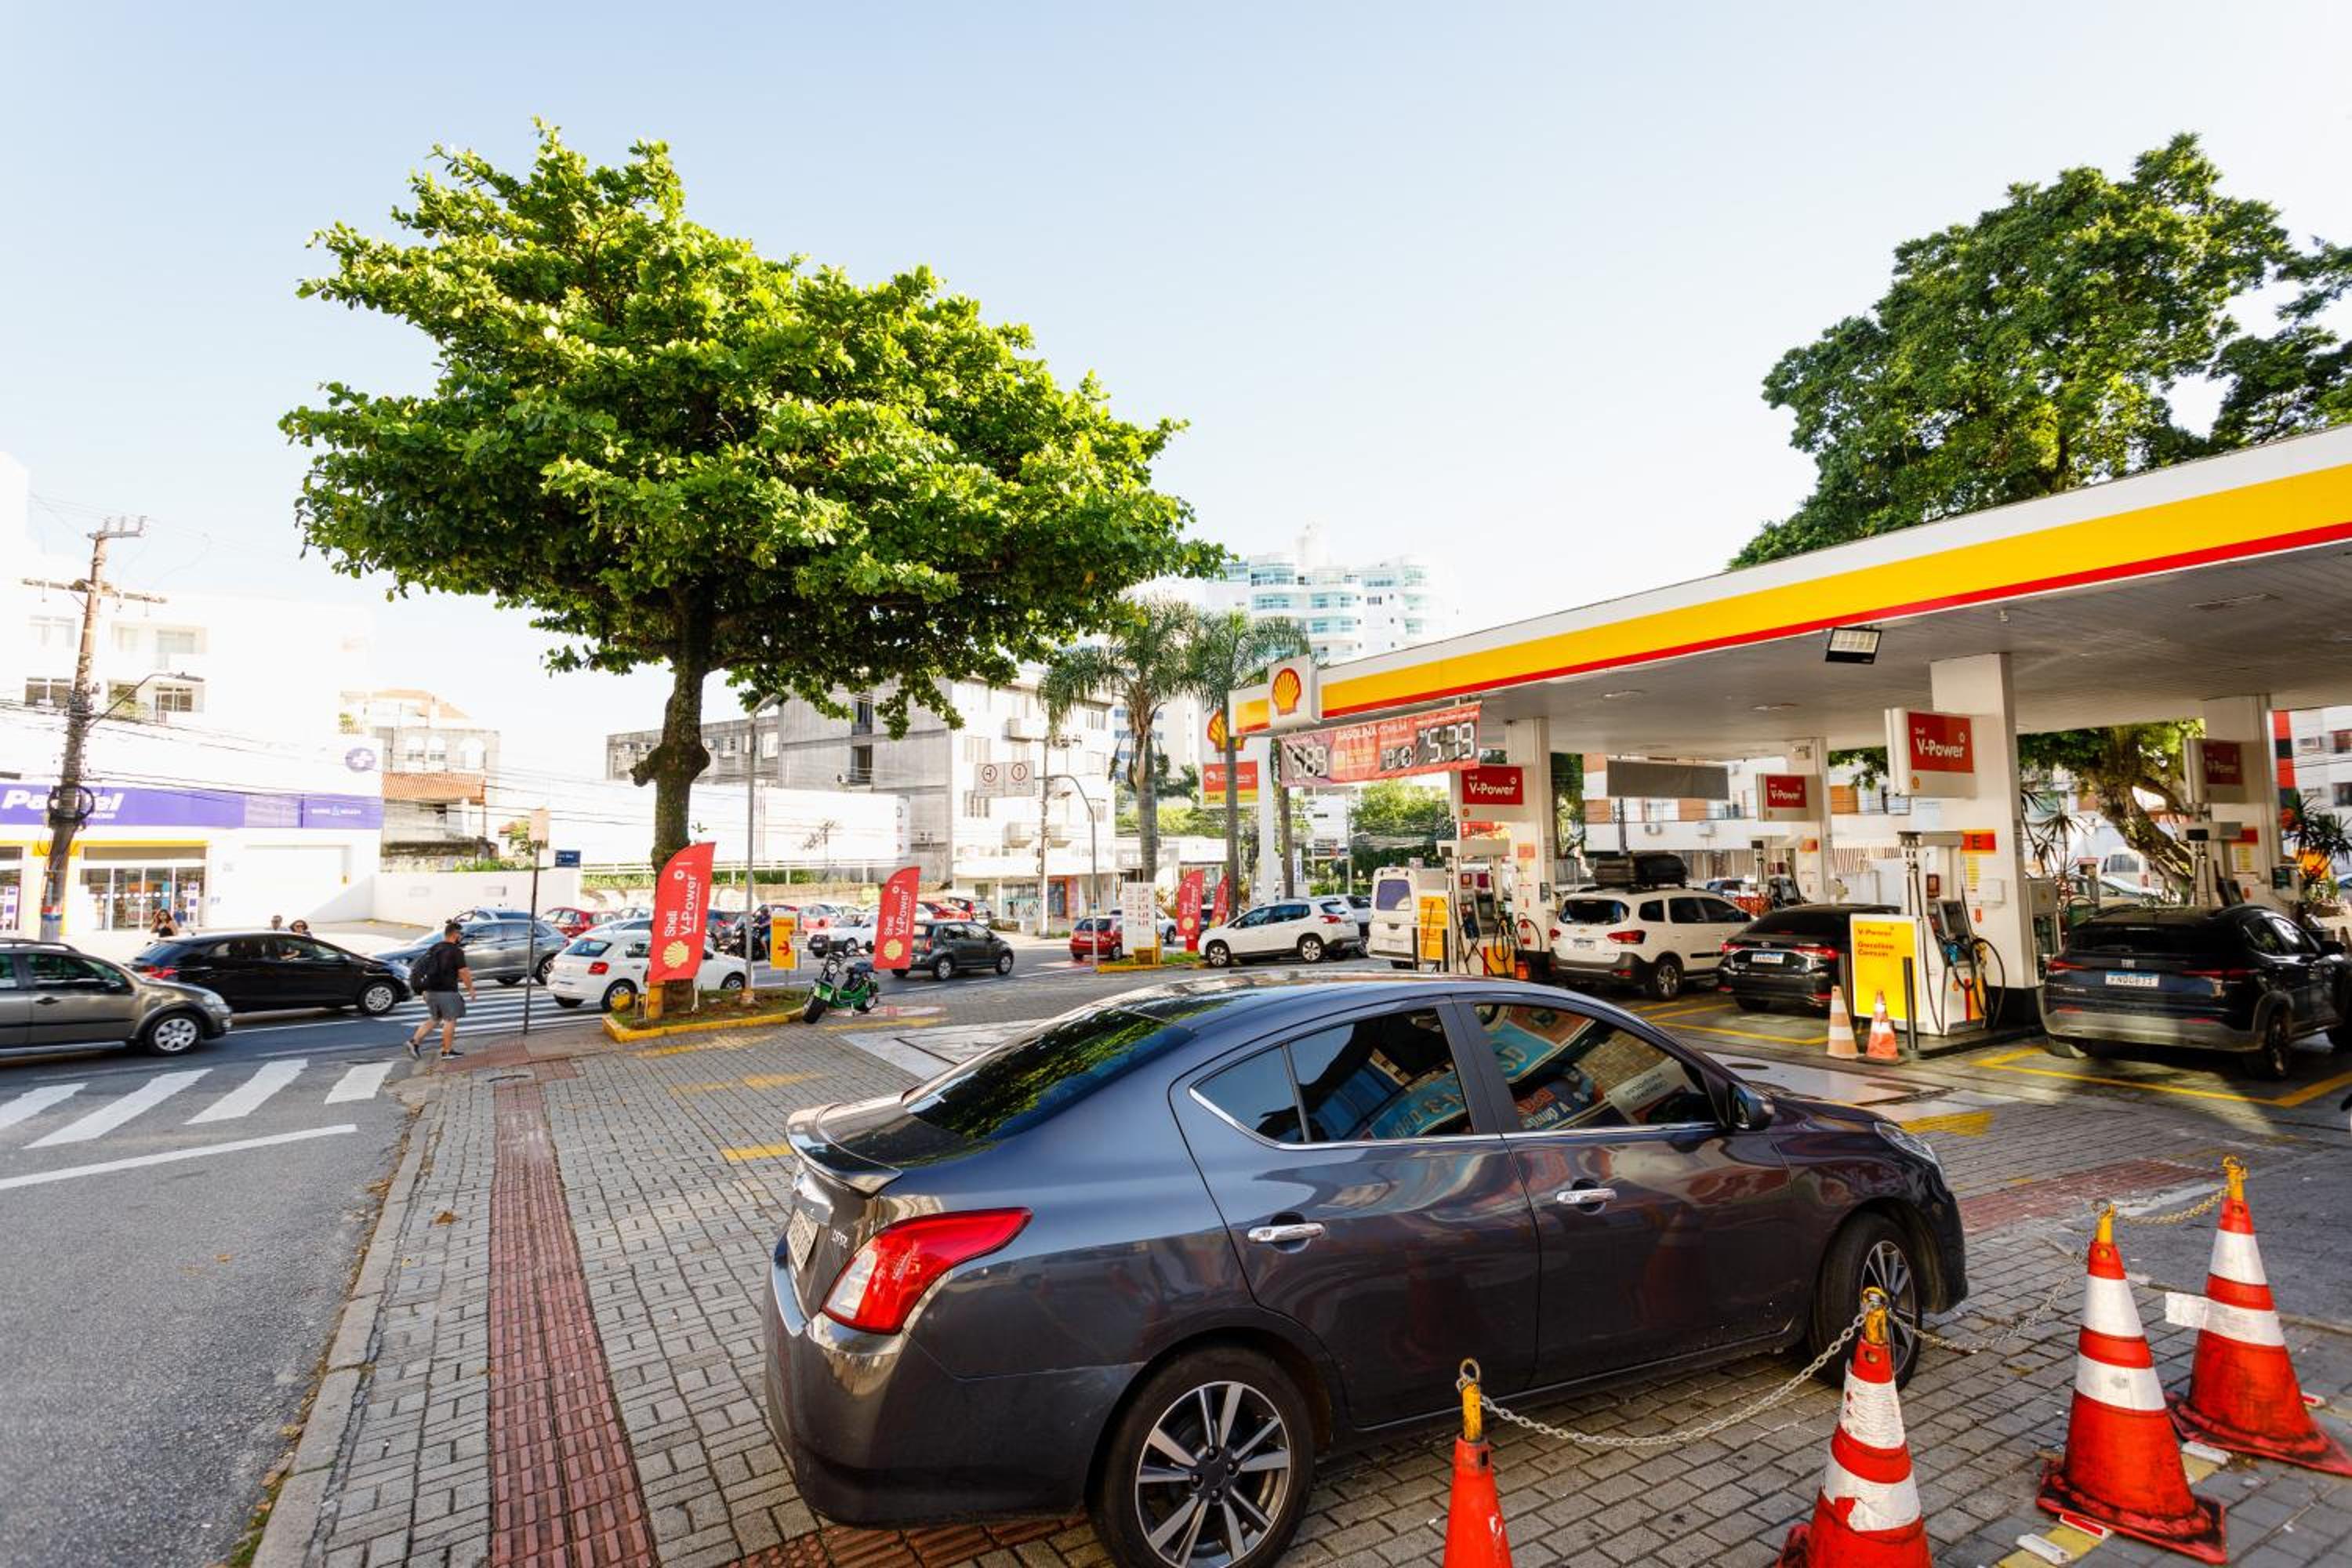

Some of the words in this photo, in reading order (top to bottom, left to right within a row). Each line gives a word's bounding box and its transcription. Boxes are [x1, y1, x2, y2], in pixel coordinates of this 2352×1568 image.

[1428, 722, 1475, 764] 5.79
[1916, 739, 1964, 758] V-Power
[2, 789, 125, 811] Pael
[1468, 782, 1515, 796] V-Power
[680, 874, 697, 936] V-Power
[665, 910, 678, 937] Shell
